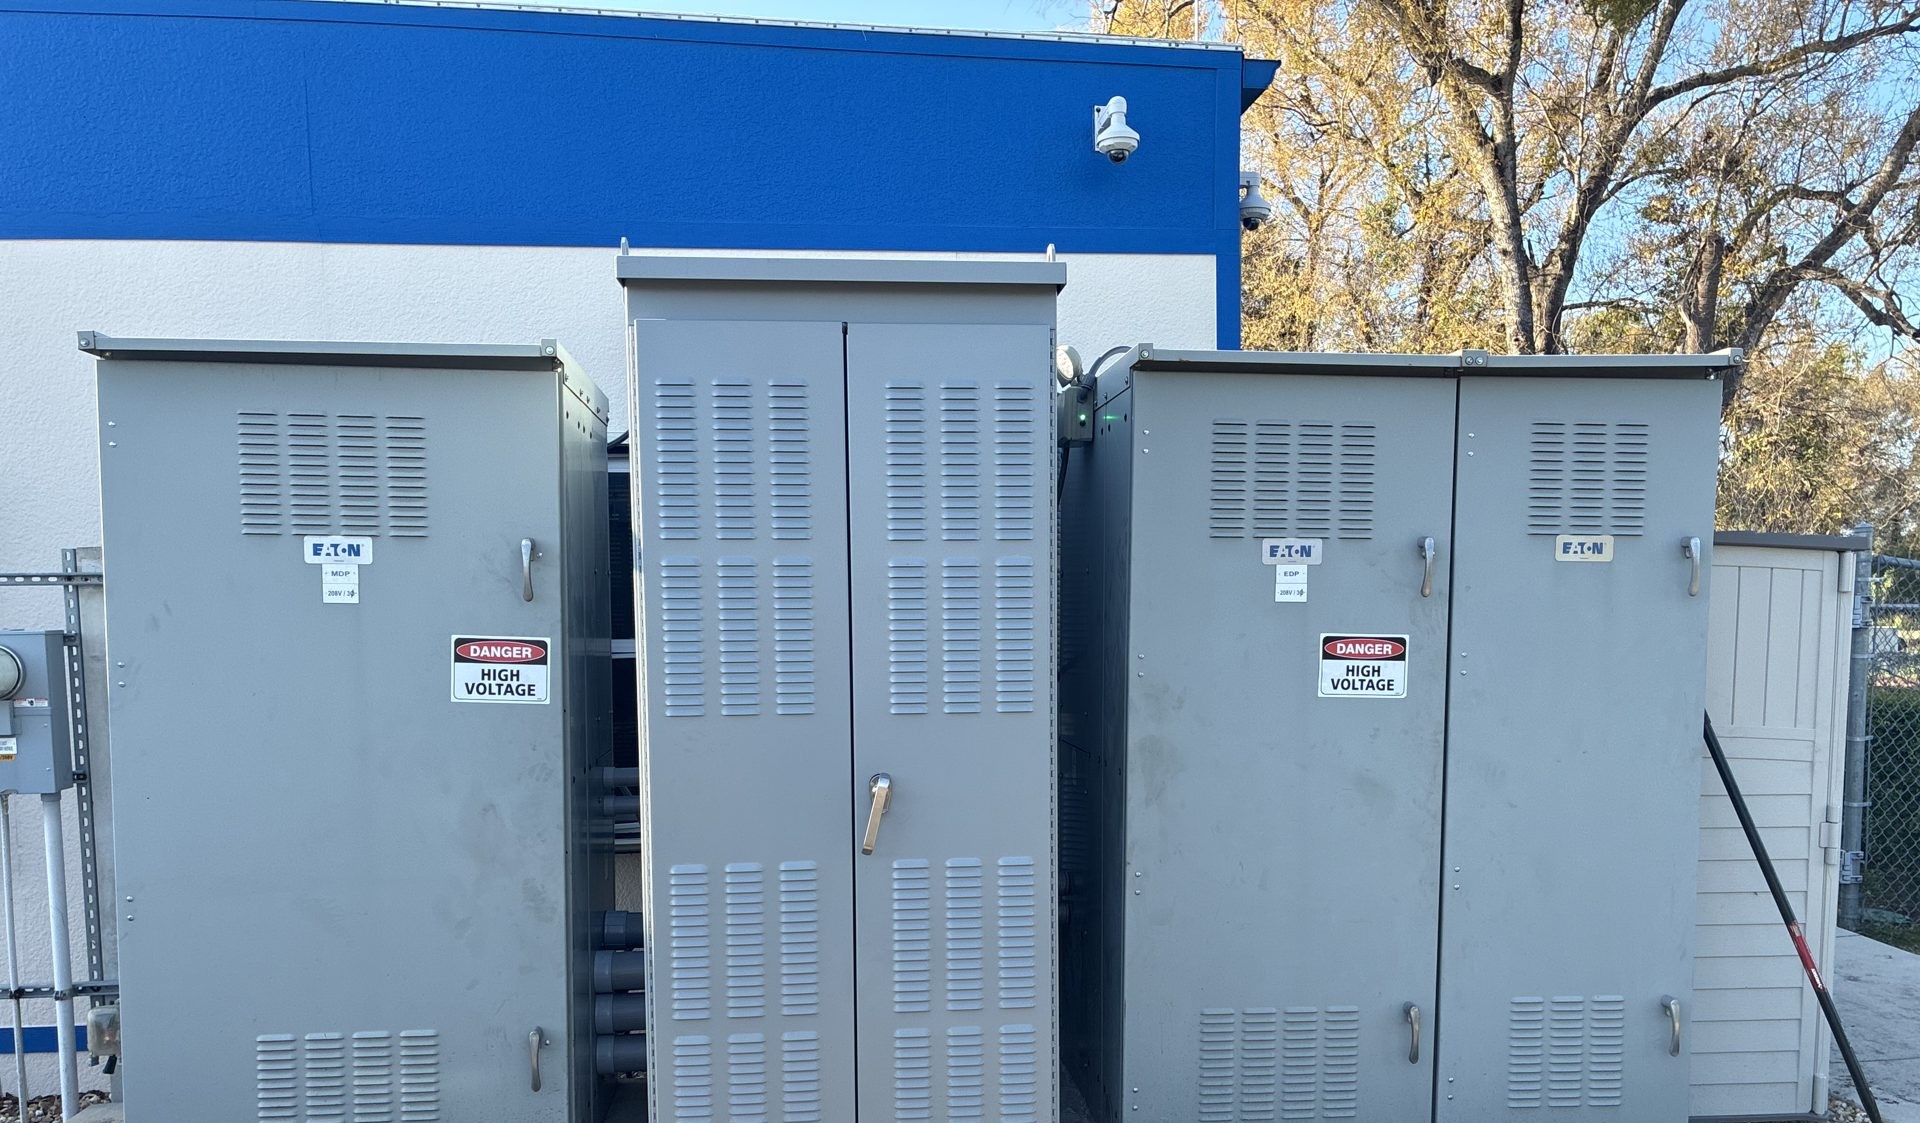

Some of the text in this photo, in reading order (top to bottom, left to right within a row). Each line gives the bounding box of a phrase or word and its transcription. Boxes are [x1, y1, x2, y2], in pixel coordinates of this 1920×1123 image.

[312, 543, 361, 557] EATON
[1269, 544, 1312, 558] EATON
[1562, 541, 1604, 555] EATON
[469, 645, 532, 658] DANGER
[1336, 643, 1392, 655] DANGER
[481, 668, 520, 682] HIGH
[1345, 665, 1381, 677] HIGH
[464, 682, 536, 696] VOLTAGE
[1330, 678, 1395, 691] VOLTAGE
